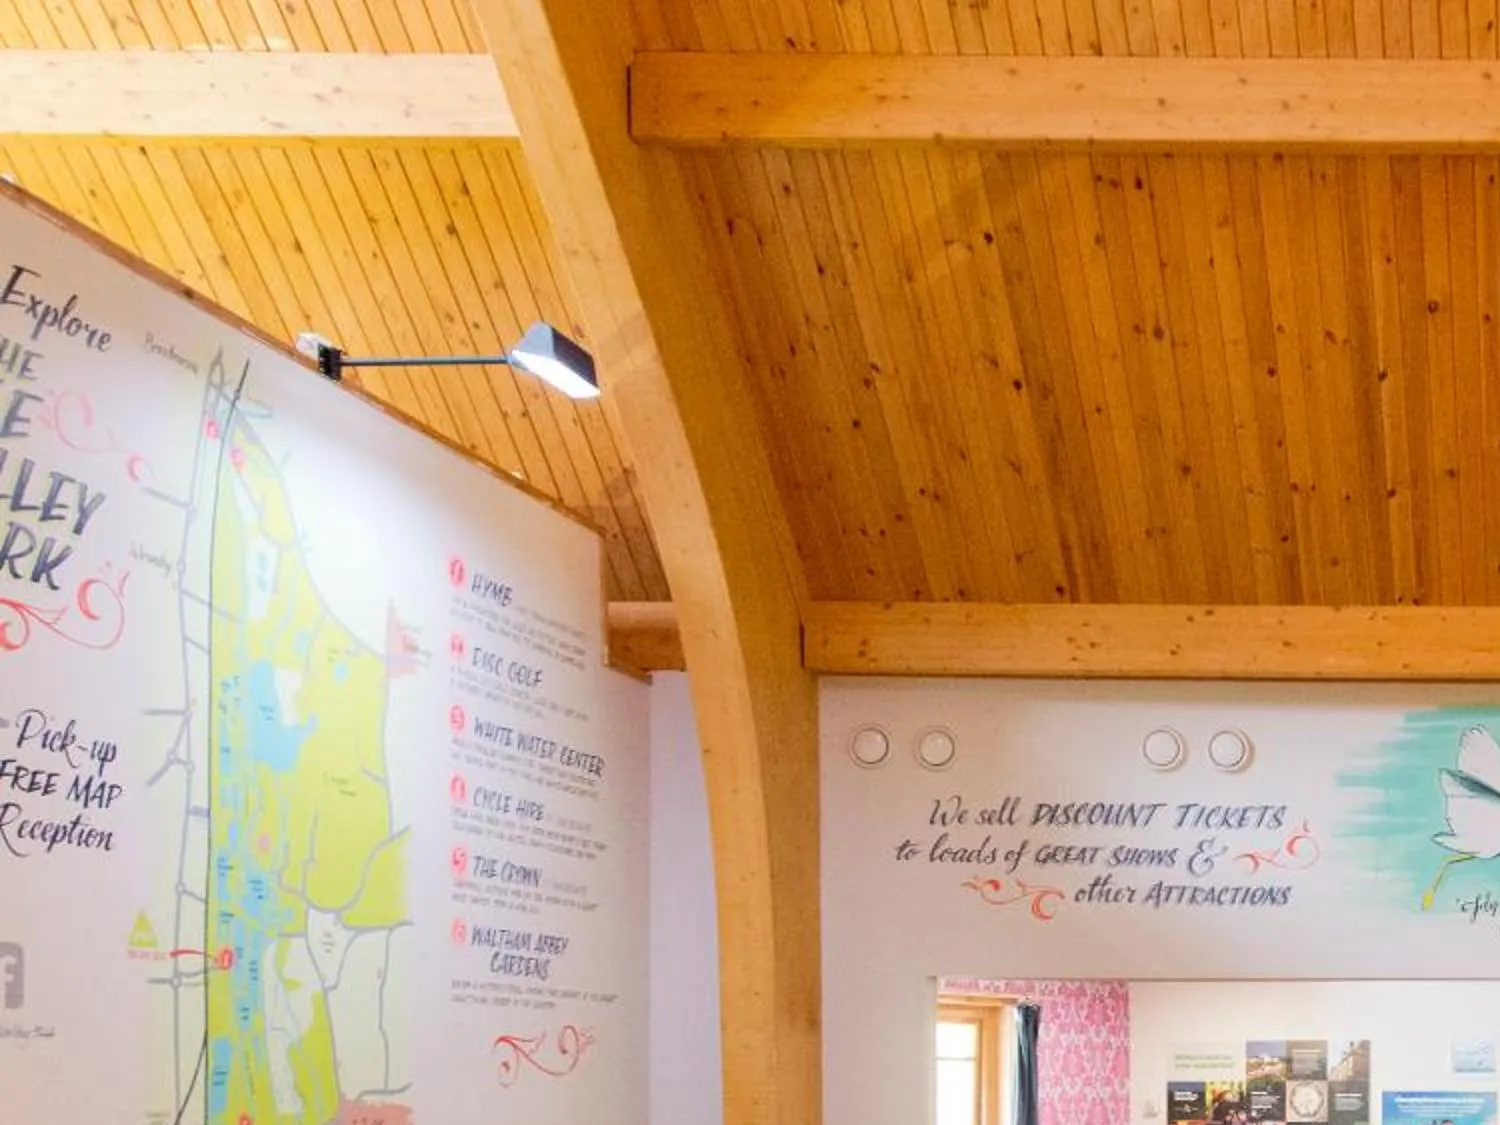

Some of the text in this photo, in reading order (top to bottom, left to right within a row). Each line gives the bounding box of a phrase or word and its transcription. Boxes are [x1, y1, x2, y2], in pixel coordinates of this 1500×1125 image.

[1, 264, 112, 352] Explore
[0, 337, 44, 381] HE
[0, 521, 73, 590] RK
[473, 647, 543, 688] DISC GOLF
[15, 708, 117, 777] Pick-up
[474, 716, 513, 747] WHITE
[517, 733, 557, 759] WATER
[560, 745, 605, 777] CENTER
[0, 759, 60, 796] FREE
[66, 775, 122, 809] MAP
[473, 786, 545, 821] CYCLE HIRE
[929, 794, 1287, 829] We sell DISCOUNT TICKETS
[0, 802, 113, 857] Reception
[474, 855, 498, 879] THE
[502, 860, 543, 887] CROWN
[896, 833, 1229, 878] to loads of GREAT SHOWS &
[1074, 872, 1293, 909] other ATTRACTIONS
[472, 924, 532, 951] WALTHAM
[490, 951, 551, 981] GARDENS
